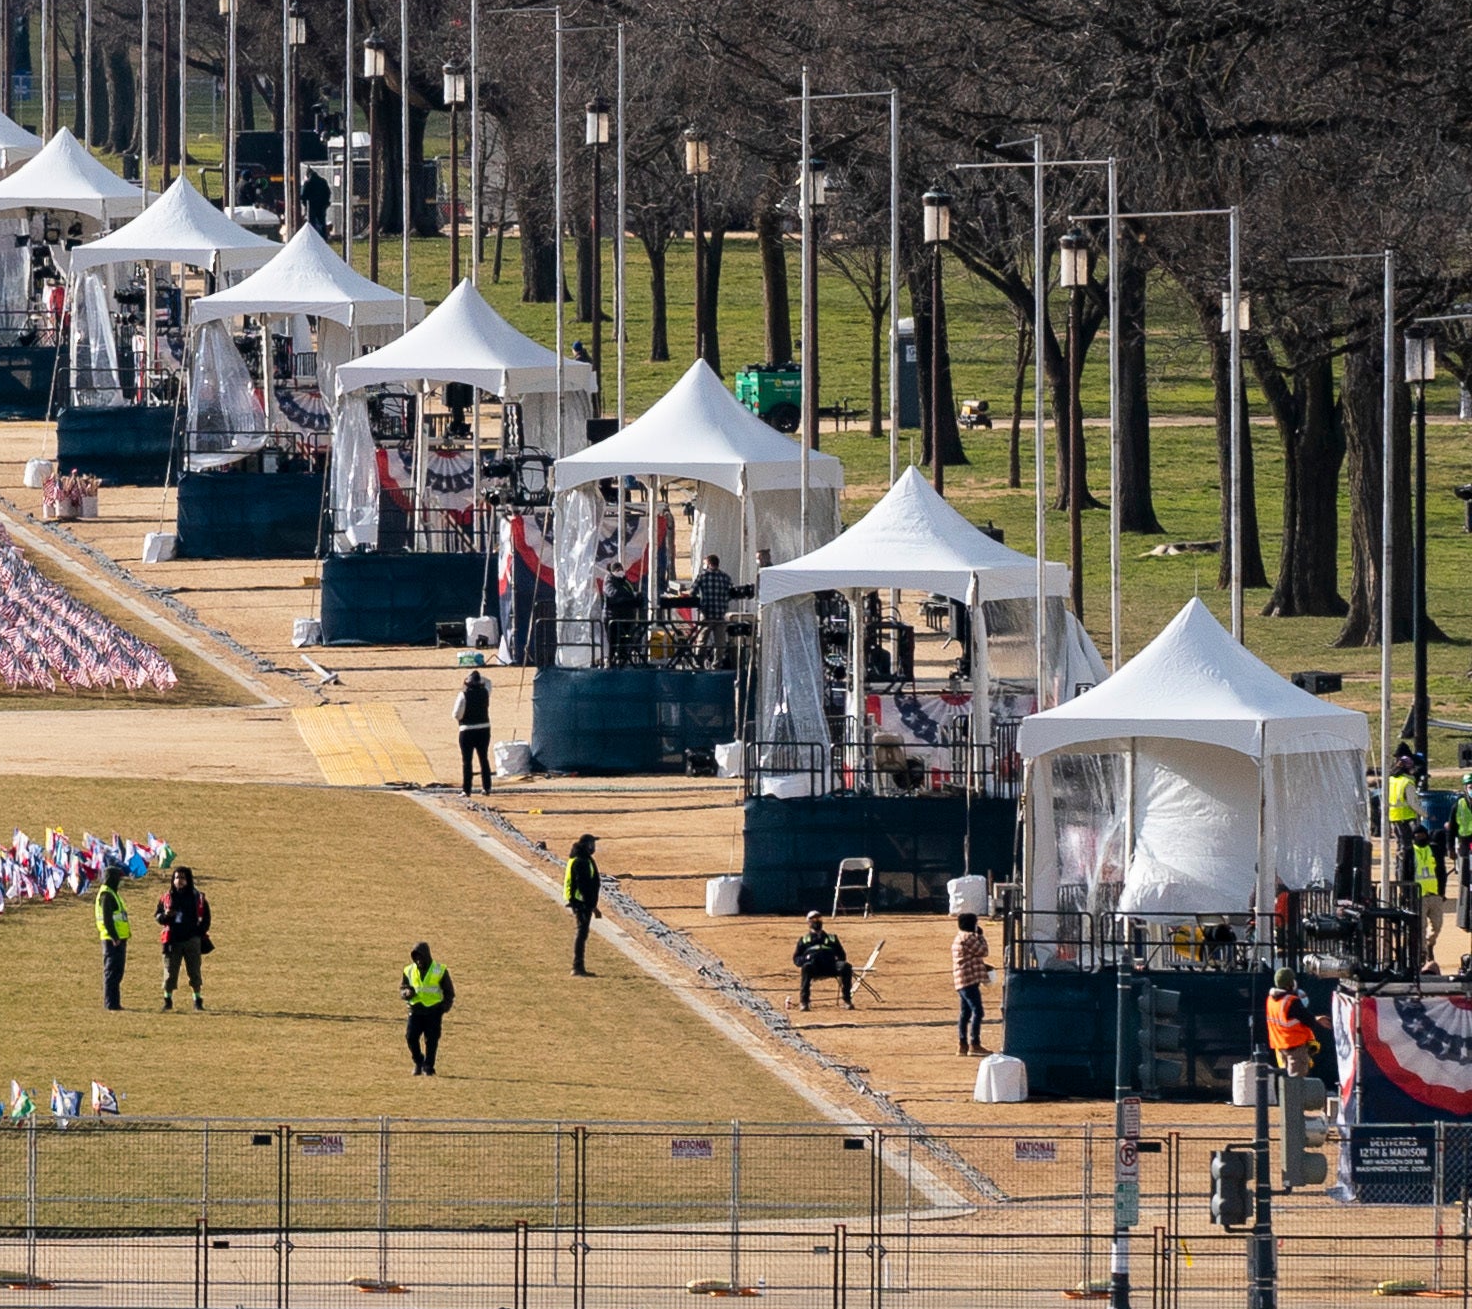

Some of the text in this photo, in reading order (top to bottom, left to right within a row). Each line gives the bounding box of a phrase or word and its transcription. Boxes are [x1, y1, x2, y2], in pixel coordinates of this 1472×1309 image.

[672, 1139, 711, 1149] NATIONAL
[1016, 1142, 1055, 1151] NATIONAL
[1359, 1148, 1428, 1157] 12TH & MADISON
